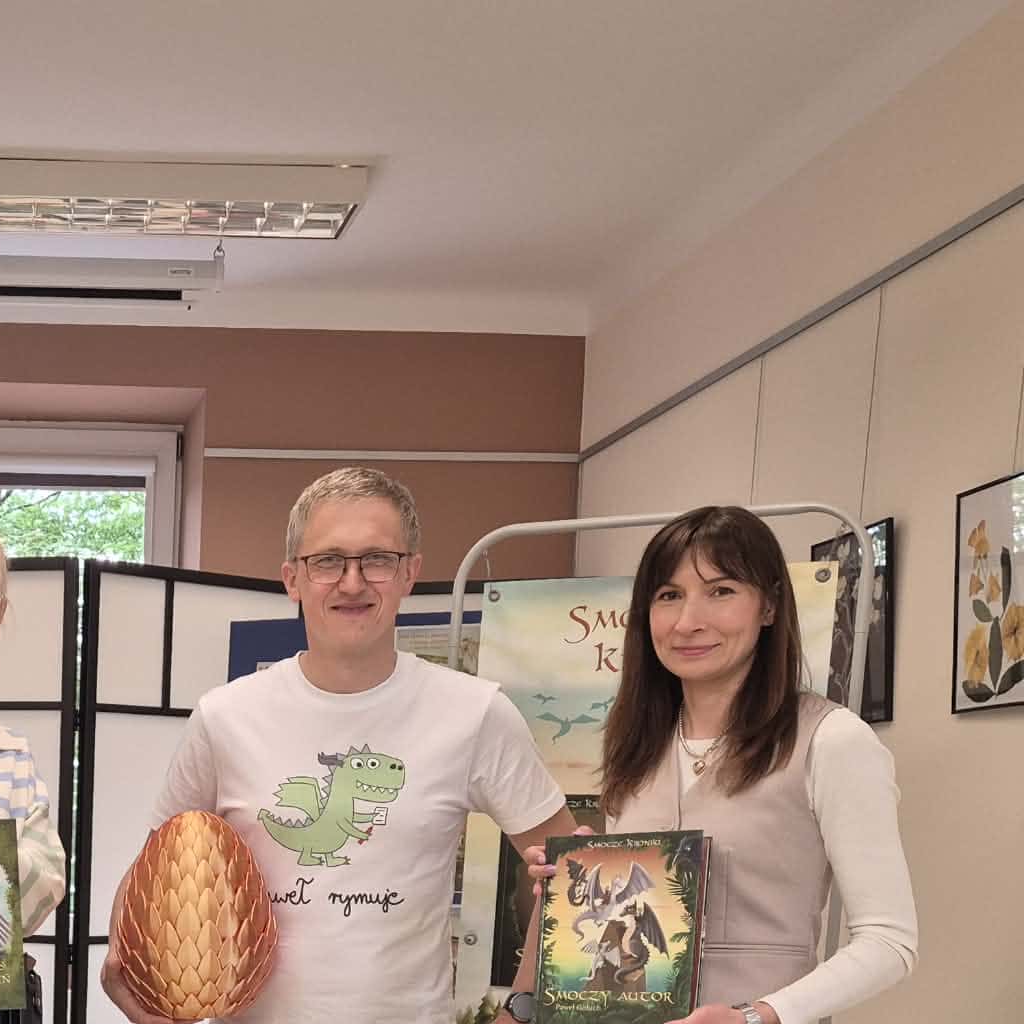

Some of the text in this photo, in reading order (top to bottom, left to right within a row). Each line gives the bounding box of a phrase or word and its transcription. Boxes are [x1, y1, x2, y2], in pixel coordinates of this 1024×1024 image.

[268, 877, 406, 917] weł rymuje
[543, 987, 675, 1008] SMOCZY AUTOR
